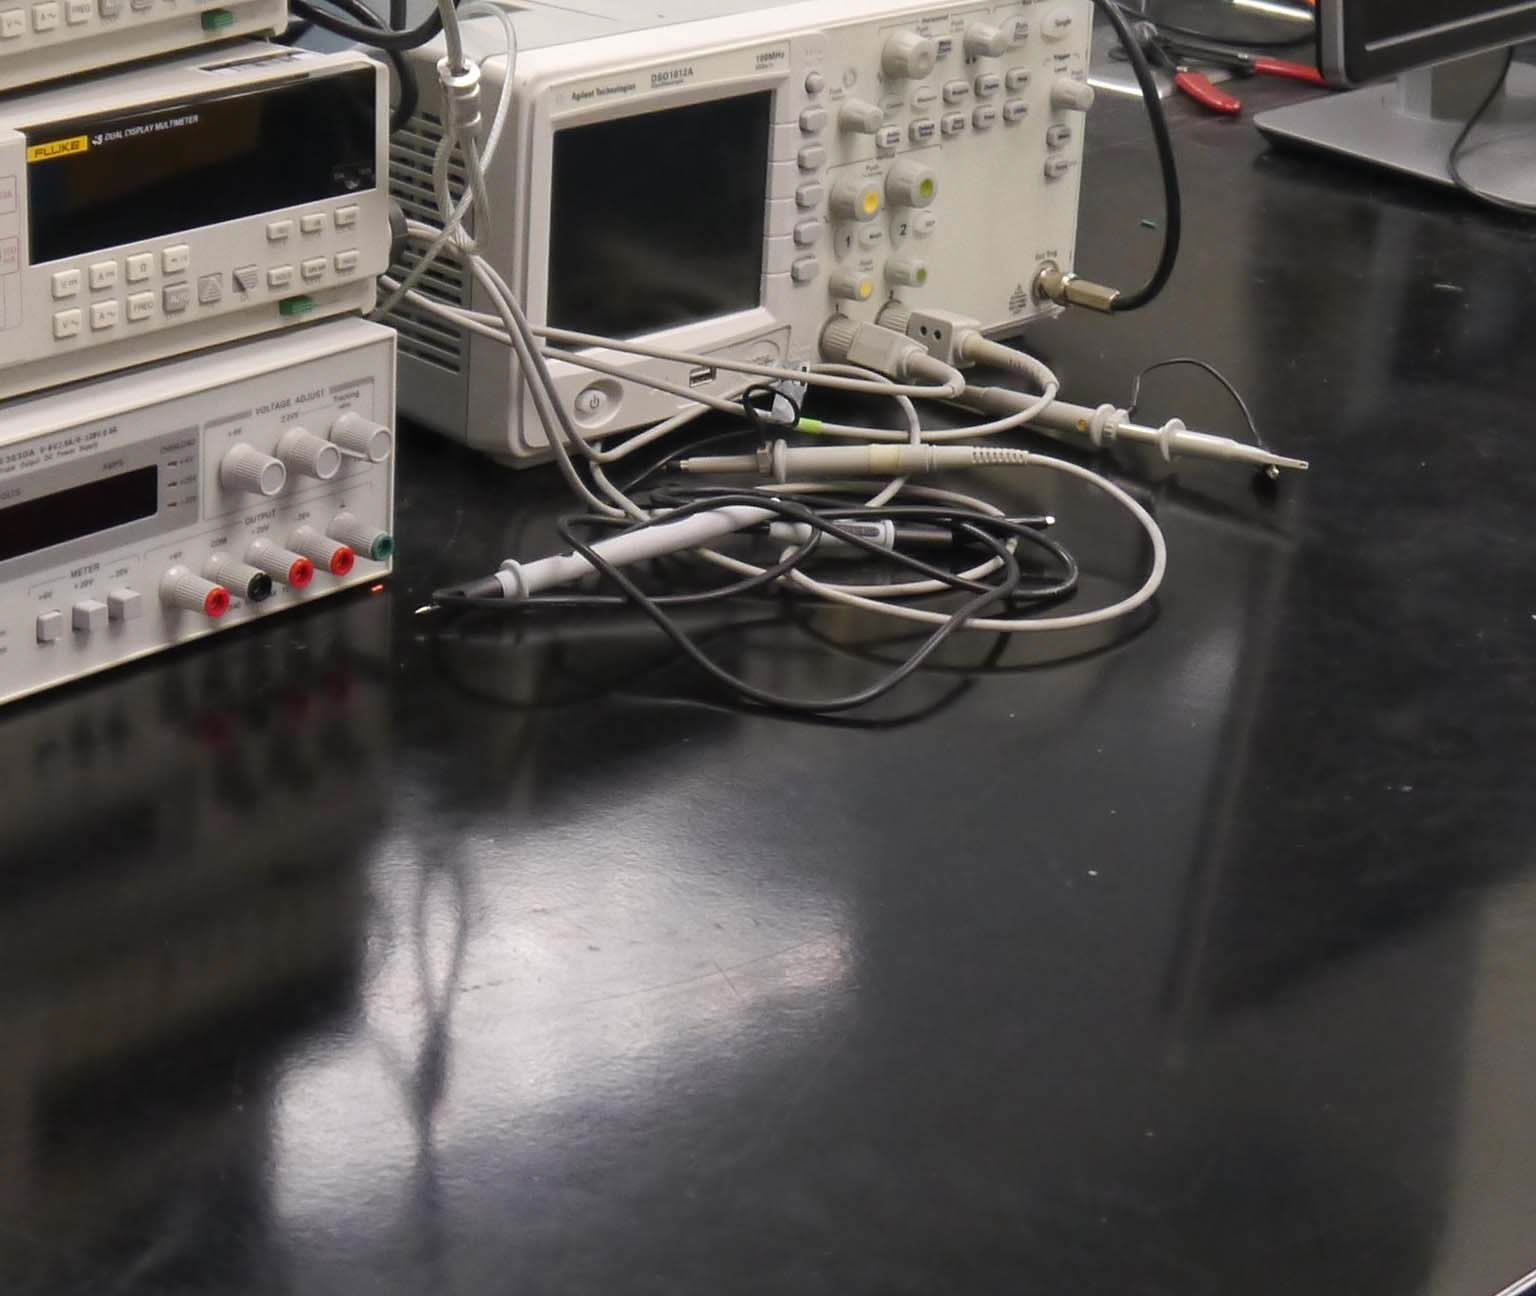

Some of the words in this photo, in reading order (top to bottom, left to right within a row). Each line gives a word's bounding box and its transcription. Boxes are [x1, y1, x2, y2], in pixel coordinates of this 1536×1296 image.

[571, 90, 595, 102] Agilent
[596, 82, 636, 97] Technologies
[124, 122, 154, 138] DISPLAY
[154, 113, 200, 132] MULTIMETER
[33, 139, 81, 160] FLUKE
[898, 223, 908, 237] 2
[844, 234, 852, 249] 1
[254, 399, 292, 417] VOLTAGE
[243, 509, 276, 527] OUTPUT
[69, 562, 101, 579] METER
